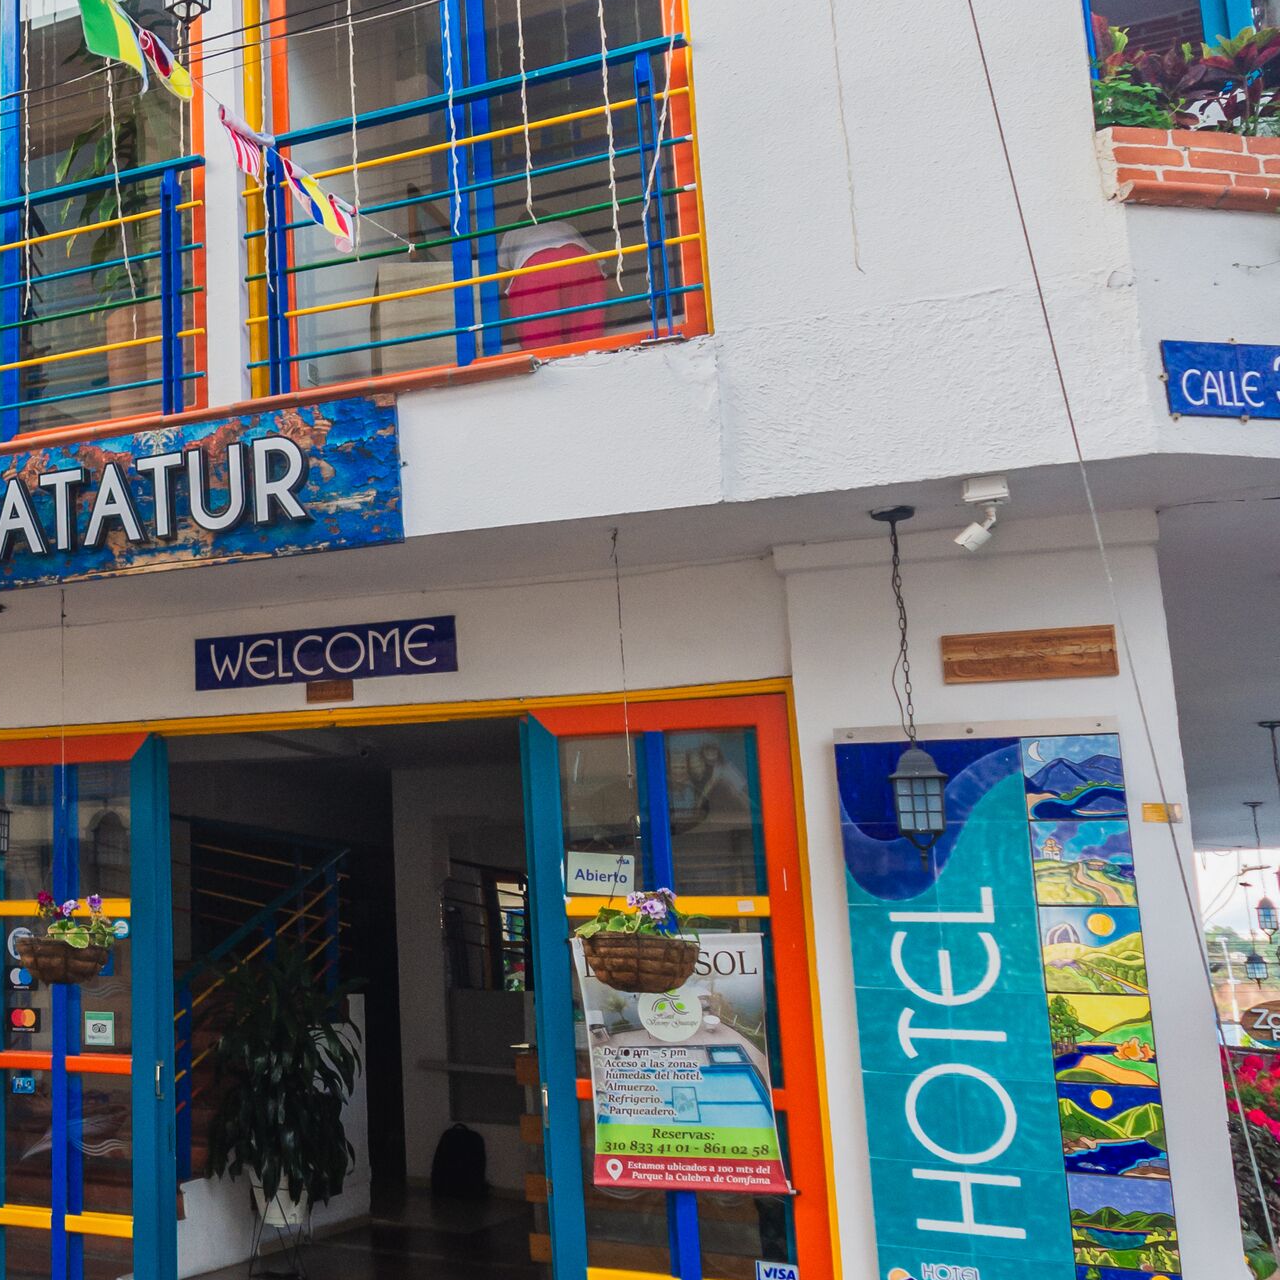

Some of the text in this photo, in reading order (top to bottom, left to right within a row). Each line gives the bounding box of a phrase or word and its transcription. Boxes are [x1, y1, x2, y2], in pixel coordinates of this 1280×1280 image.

[1182, 369, 1265, 407] CALLE
[208, 623, 437, 681] WELCOME
[575, 868, 628, 883] Abierto
[603, 1047, 616, 1056] De
[661, 1049, 667, 1058] 5
[670, 1049, 687, 1058] pm
[604, 1059, 638, 1068] Acceso
[649, 1059, 665, 1068] las
[889, 886, 1027, 1239] HOTEL
[605, 1070, 703, 1080] húmedas del hotel.
[607, 1082, 658, 1092] Almuerzo.
[608, 1094, 663, 1105] Refrigerio.
[609, 1106, 677, 1117] Parqueadero.
[652, 1128, 715, 1140] Reservas:
[604, 1141, 626, 1152] 310
[629, 1140, 653, 1153] 833
[657, 1142, 671, 1154] 41
[675, 1144, 690, 1153] 01
[703, 1143, 727, 1154] 861
[730, 1145, 748, 1155] 02
[751, 1143, 769, 1156] 58
[627, 1160, 665, 1170] Estamos
[667, 1161, 707, 1172] ubicados
[709, 1165, 715, 1173] a
[736, 1165, 754, 1174] mts
[755, 1164, 771, 1174] del
[632, 1171, 771, 1186] Parque la Culebra de Comfama
[763, 1267, 797, 1280] VISA
